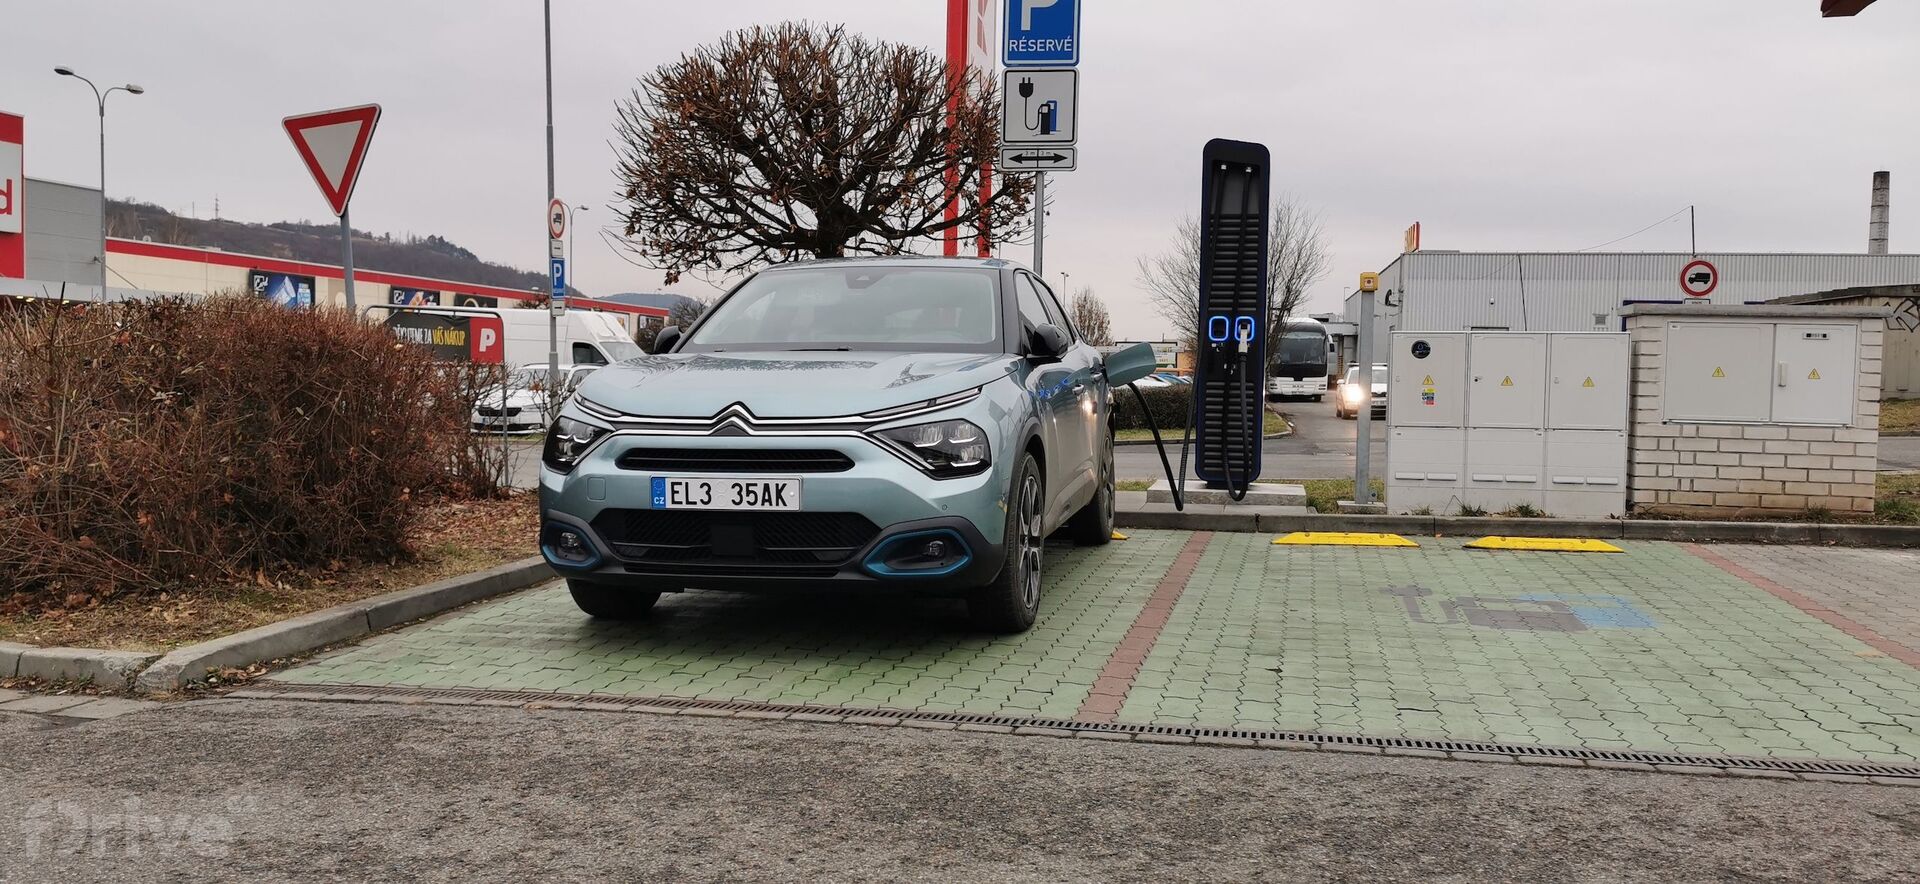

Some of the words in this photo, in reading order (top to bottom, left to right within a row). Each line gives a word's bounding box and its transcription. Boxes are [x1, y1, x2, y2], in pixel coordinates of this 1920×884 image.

[1009, 35, 1072, 52] RÉSERVÉ
[553, 263, 562, 286] P
[424, 328, 432, 344] ZA
[444, 326, 466, 346] NÁKUP
[479, 328, 496, 352] P
[653, 496, 665, 504] CZ
[670, 481, 712, 505] EL3
[731, 482, 788, 507] 35AK
